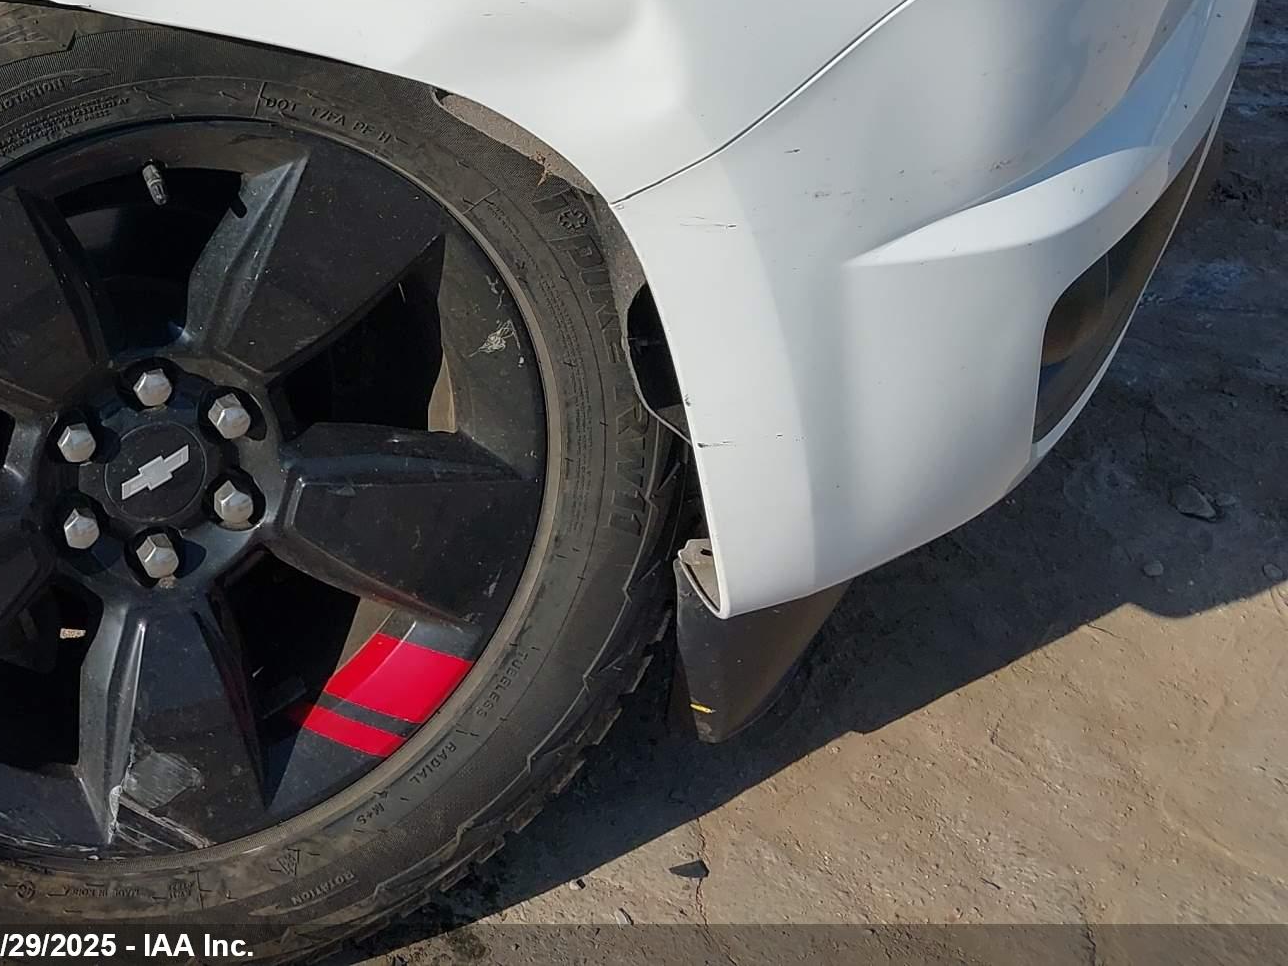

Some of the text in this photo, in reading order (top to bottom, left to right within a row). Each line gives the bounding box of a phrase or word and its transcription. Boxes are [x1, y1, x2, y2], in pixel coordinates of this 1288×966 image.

[475, 650, 529, 718] TUBELESS
[408, 740, 458, 785] RADIAL
[355, 800, 386, 825] M+S
[290, 870, 356, 907] ROTATION
